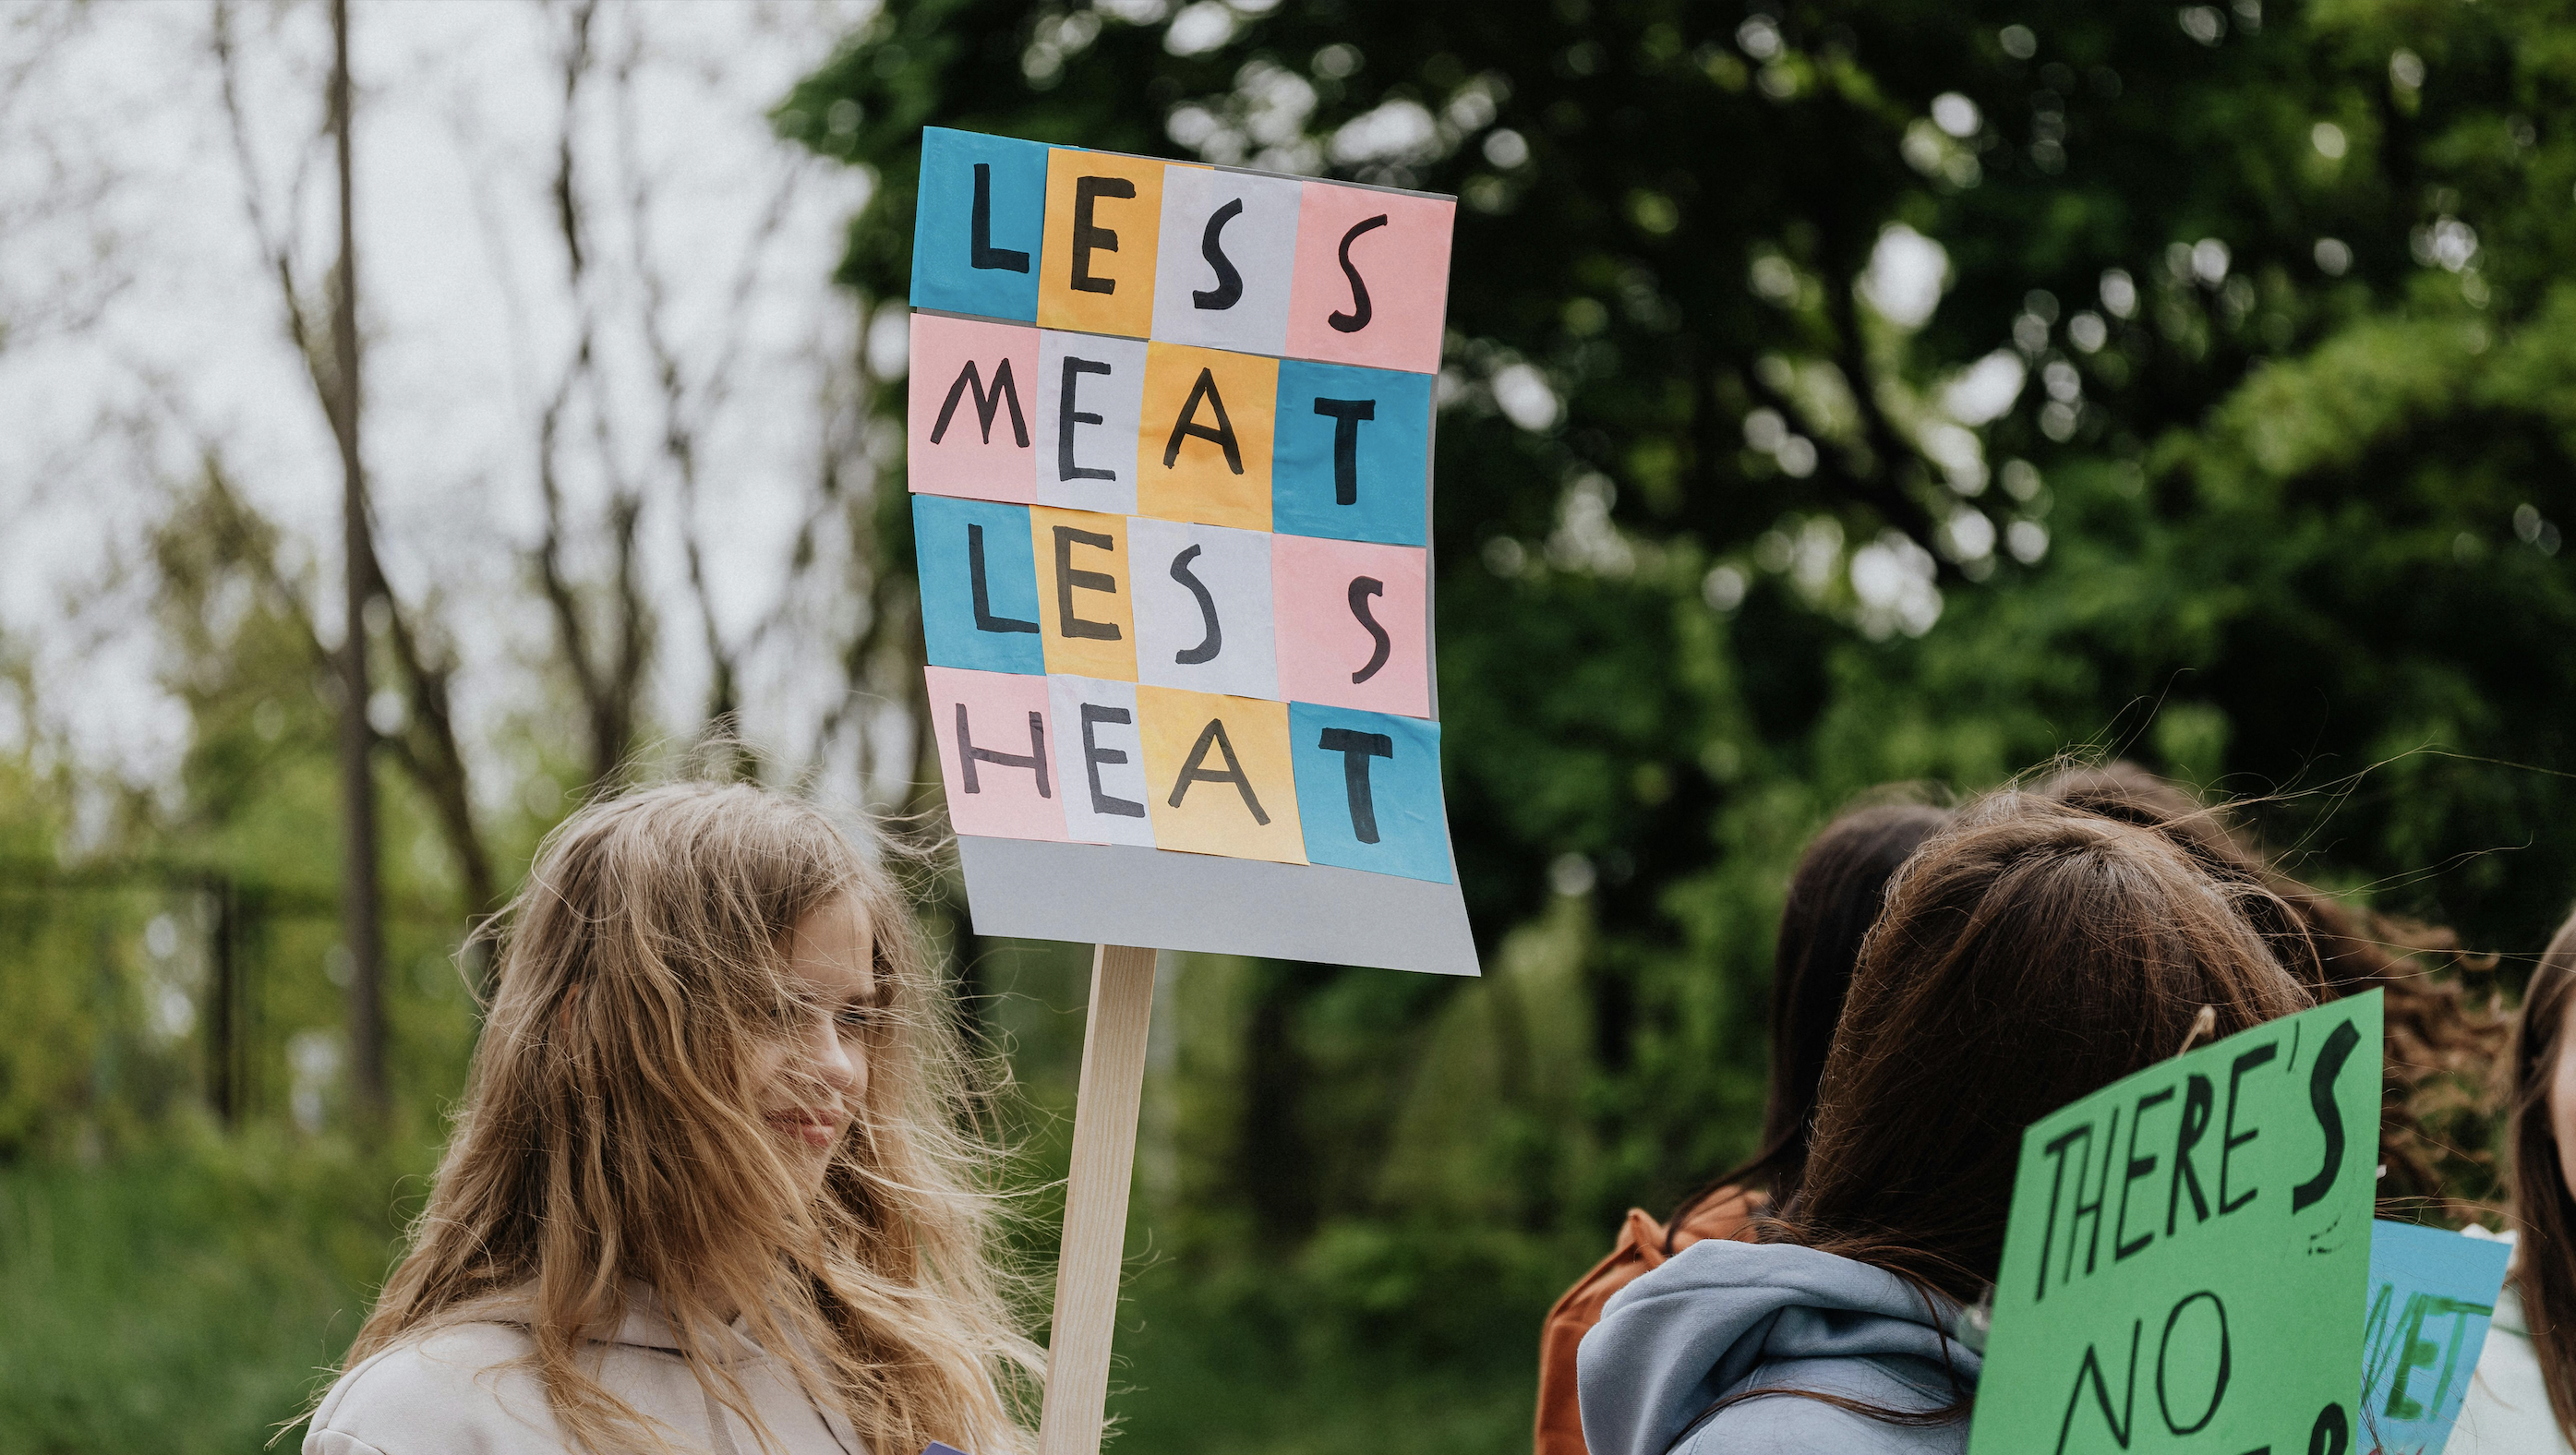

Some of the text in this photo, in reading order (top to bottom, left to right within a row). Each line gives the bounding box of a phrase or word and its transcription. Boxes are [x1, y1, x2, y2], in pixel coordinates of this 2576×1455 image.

[971, 163, 1388, 333] LESS
[930, 356, 1376, 506] MEAT
[968, 523, 1391, 684] LESS
[955, 702, 1393, 844] HEAT
[2035, 1018, 2362, 1304] THERE'S
[2055, 1290, 2232, 1455] NO
